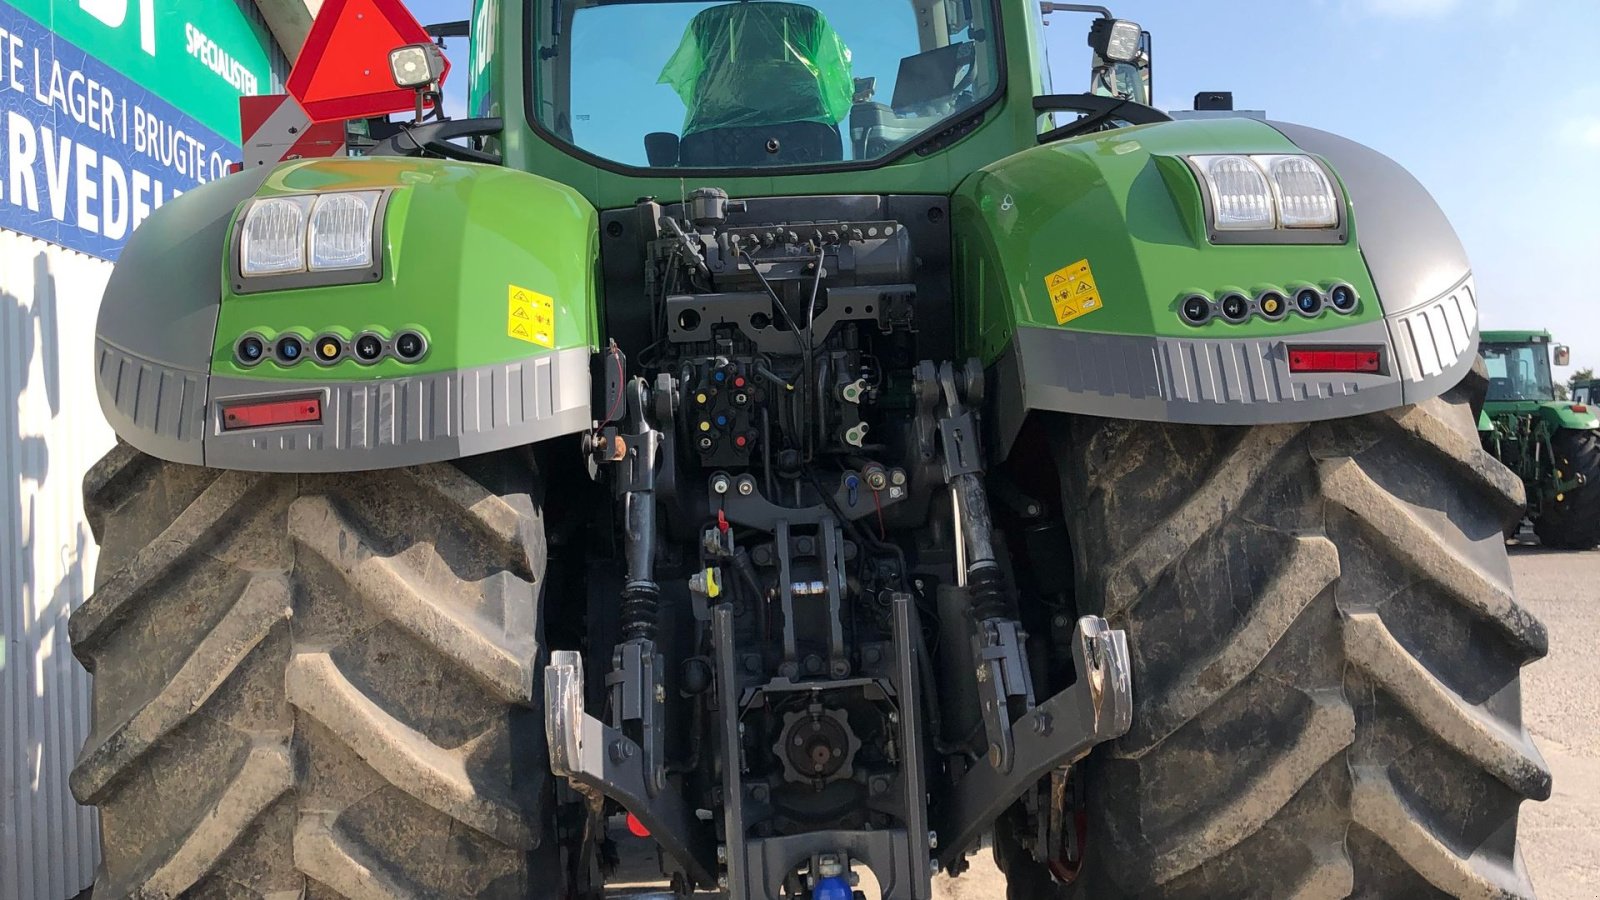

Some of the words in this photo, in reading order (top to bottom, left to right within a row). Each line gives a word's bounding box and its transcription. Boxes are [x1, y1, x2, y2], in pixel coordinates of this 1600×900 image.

[185, 22, 258, 96] SPECIALISTEN
[34, 47, 116, 140] LAGER
[122, 98, 127, 145] I
[134, 105, 206, 185] BRUGTE
